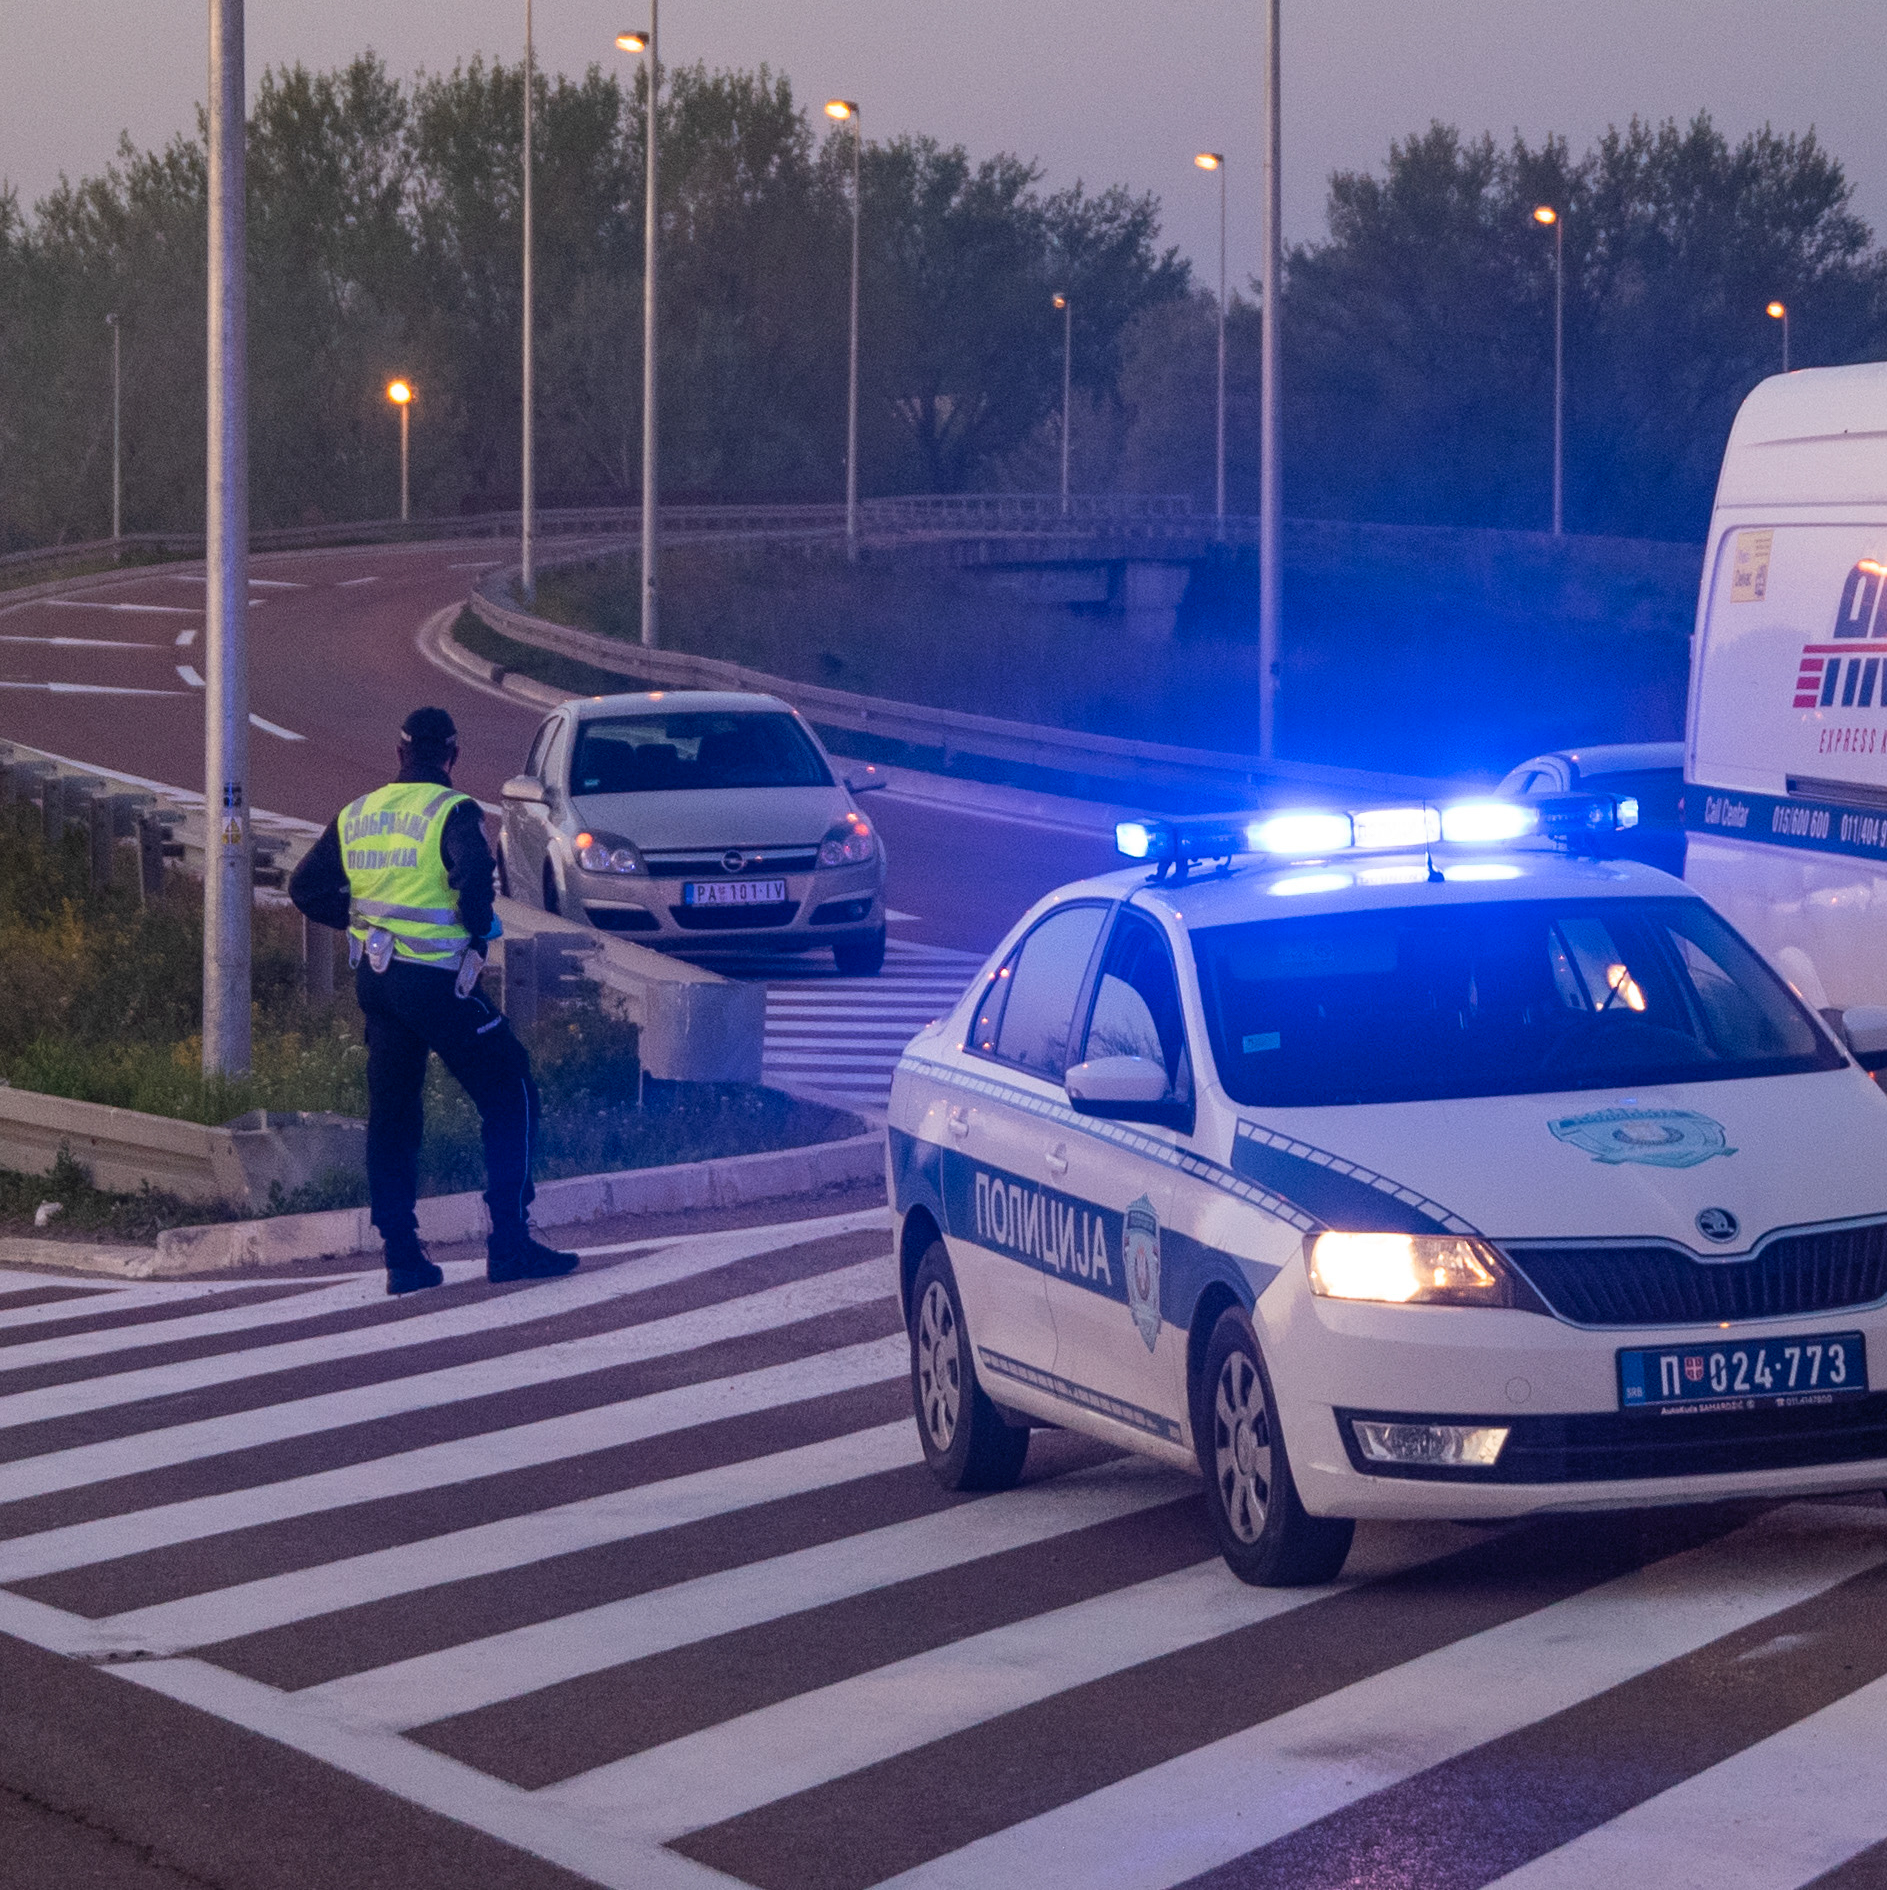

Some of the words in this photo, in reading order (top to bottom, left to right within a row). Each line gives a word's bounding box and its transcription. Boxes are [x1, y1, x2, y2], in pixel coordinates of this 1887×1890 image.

[1818, 727, 1877, 754] EXPRESS
[1704, 795, 1723, 825] Call
[1810, 810, 1831, 840] 600
[696, 884, 717, 902] PA
[975, 1171, 1112, 1286] ПОЛИЦИЈА
[1625, 1386, 1644, 1399] SRB
[1659, 1355, 1681, 1397] П
